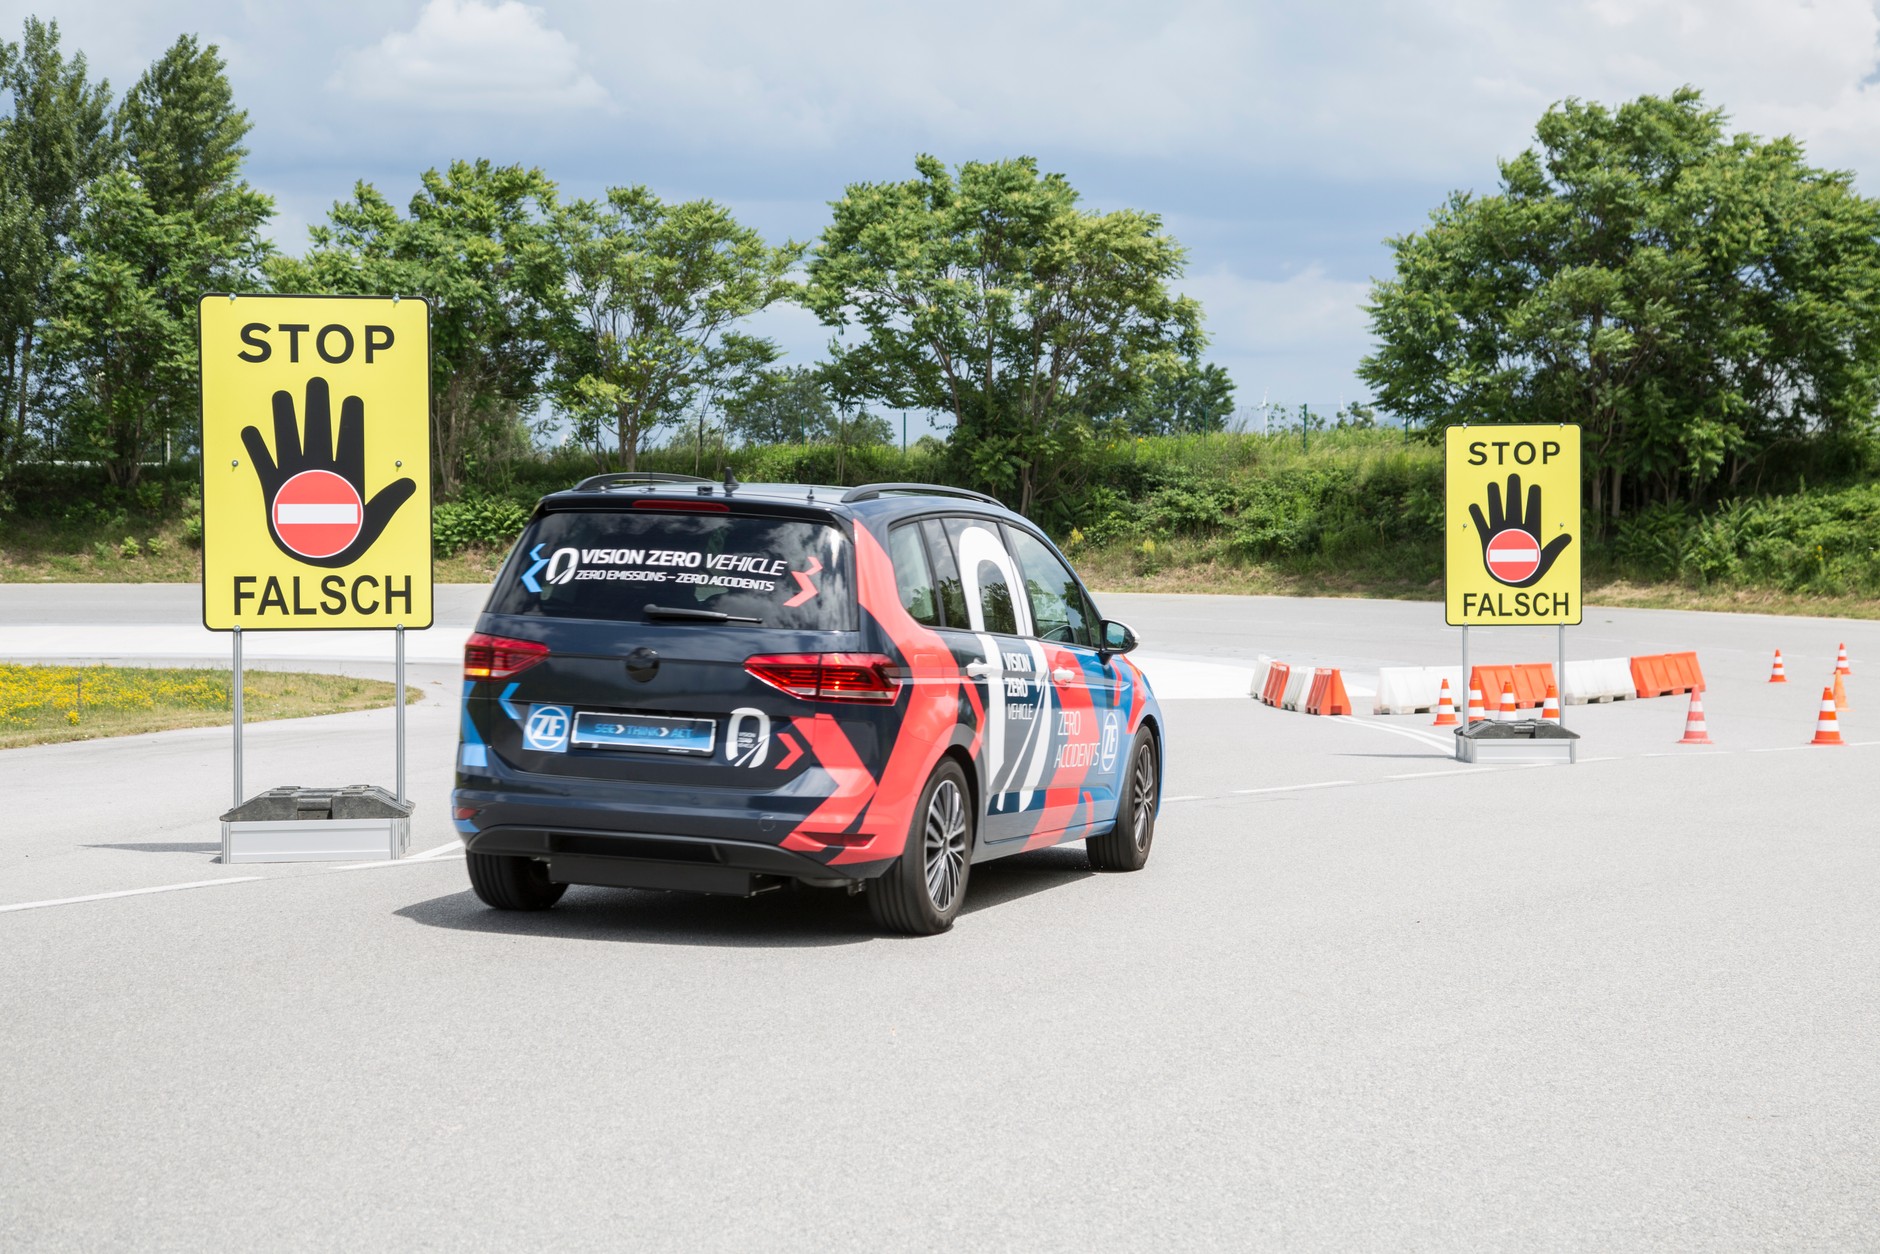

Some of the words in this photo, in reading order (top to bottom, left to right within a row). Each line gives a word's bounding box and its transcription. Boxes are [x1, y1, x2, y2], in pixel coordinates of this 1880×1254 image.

[237, 322, 395, 364] STOP
[1467, 441, 1561, 465] STOP
[581, 549, 646, 564] VISION
[645, 550, 702, 568] ZERO
[706, 553, 788, 576] VEHICLE
[574, 570, 607, 580] ZERO
[606, 570, 668, 582] EMISSIONS
[675, 573, 709, 585] ZERO
[708, 575, 775, 591] ACCIDENTS
[233, 575, 412, 616] FALSCH
[1463, 592, 1569, 617] FALSCH
[1002, 652, 1033, 673] VISION
[1005, 677, 1029, 697] ZERO
[1007, 703, 1034, 720] VEHICLE
[1057, 711, 1081, 735] ZERO
[530, 713, 567, 741] ZF
[1053, 743, 1101, 768] ACCIDENTS
